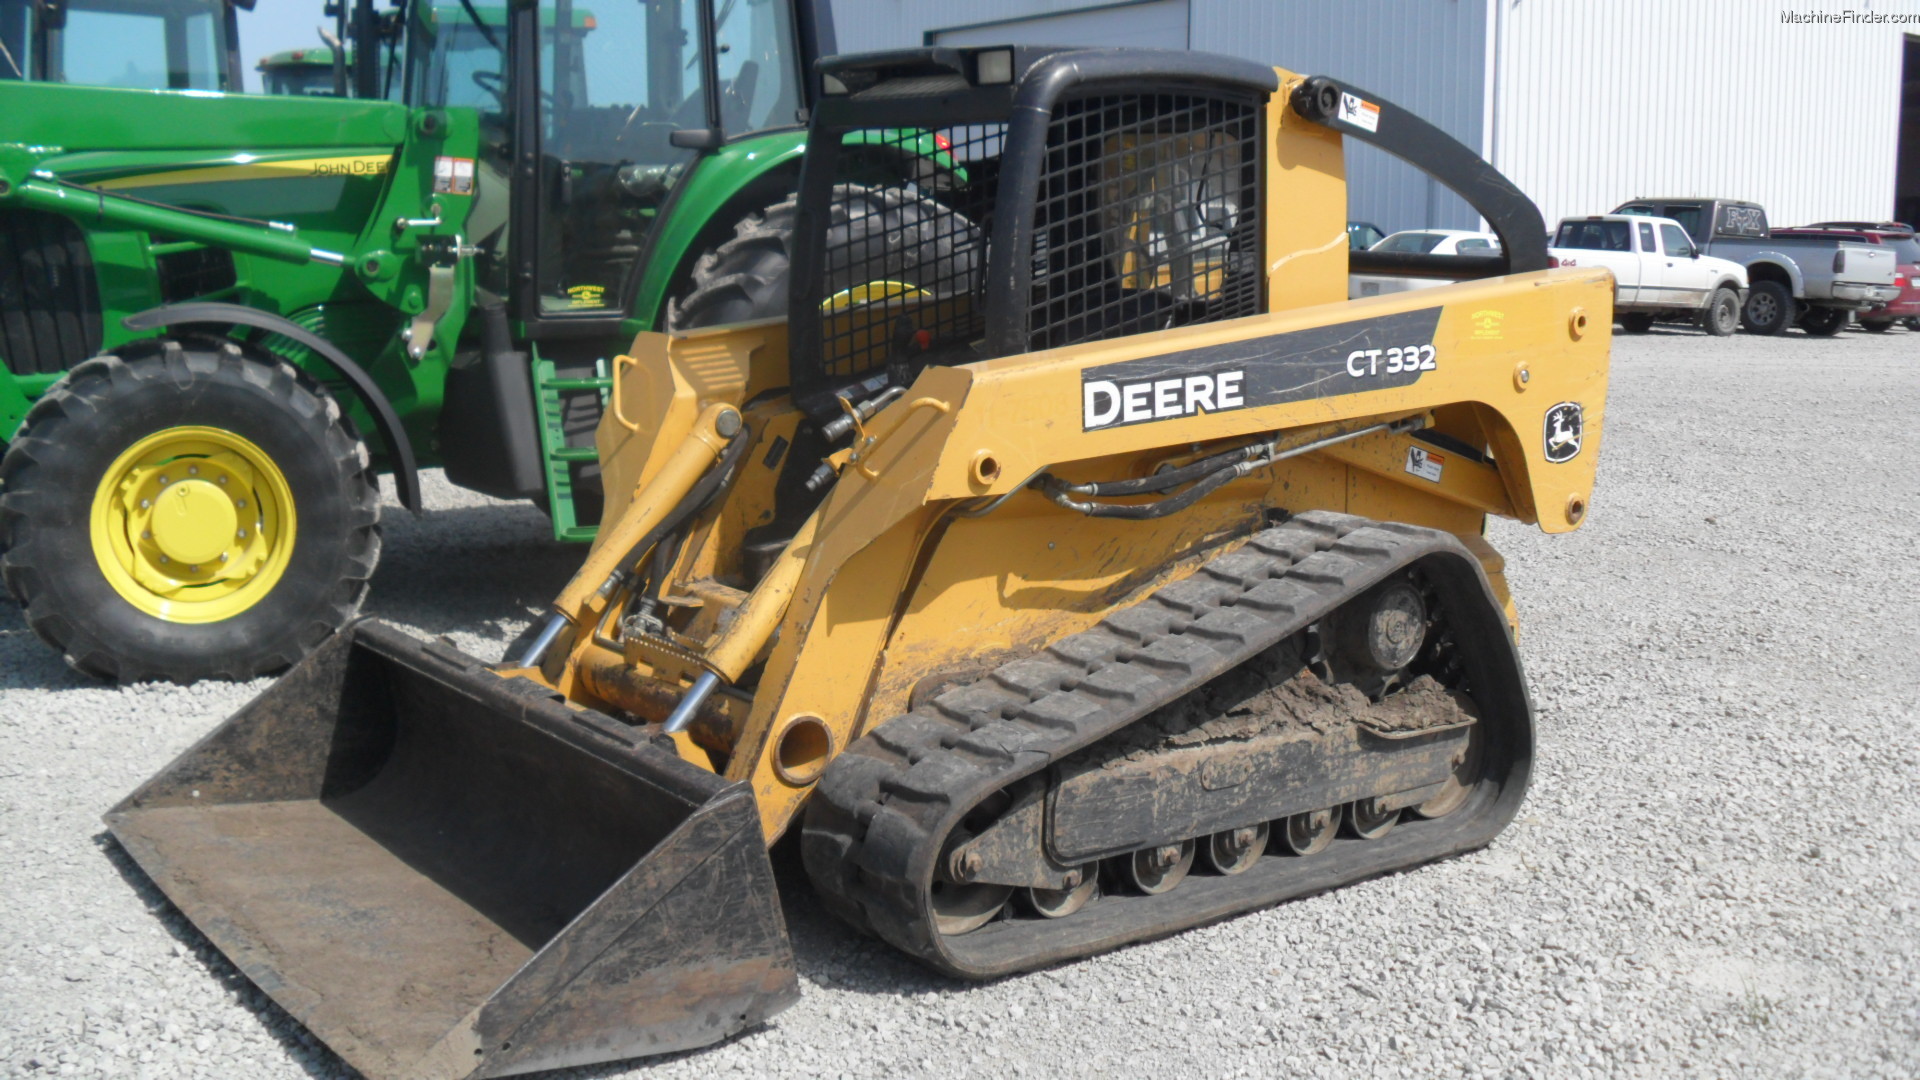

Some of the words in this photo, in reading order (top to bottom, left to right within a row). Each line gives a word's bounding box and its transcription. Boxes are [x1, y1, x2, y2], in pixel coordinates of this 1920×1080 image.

[310, 161, 350, 176] JOHN
[354, 160, 390, 174] DEE
[1346, 350, 1382, 377] CT
[1386, 344, 1437, 375] 332
[1083, 370, 1244, 428] DEERE
